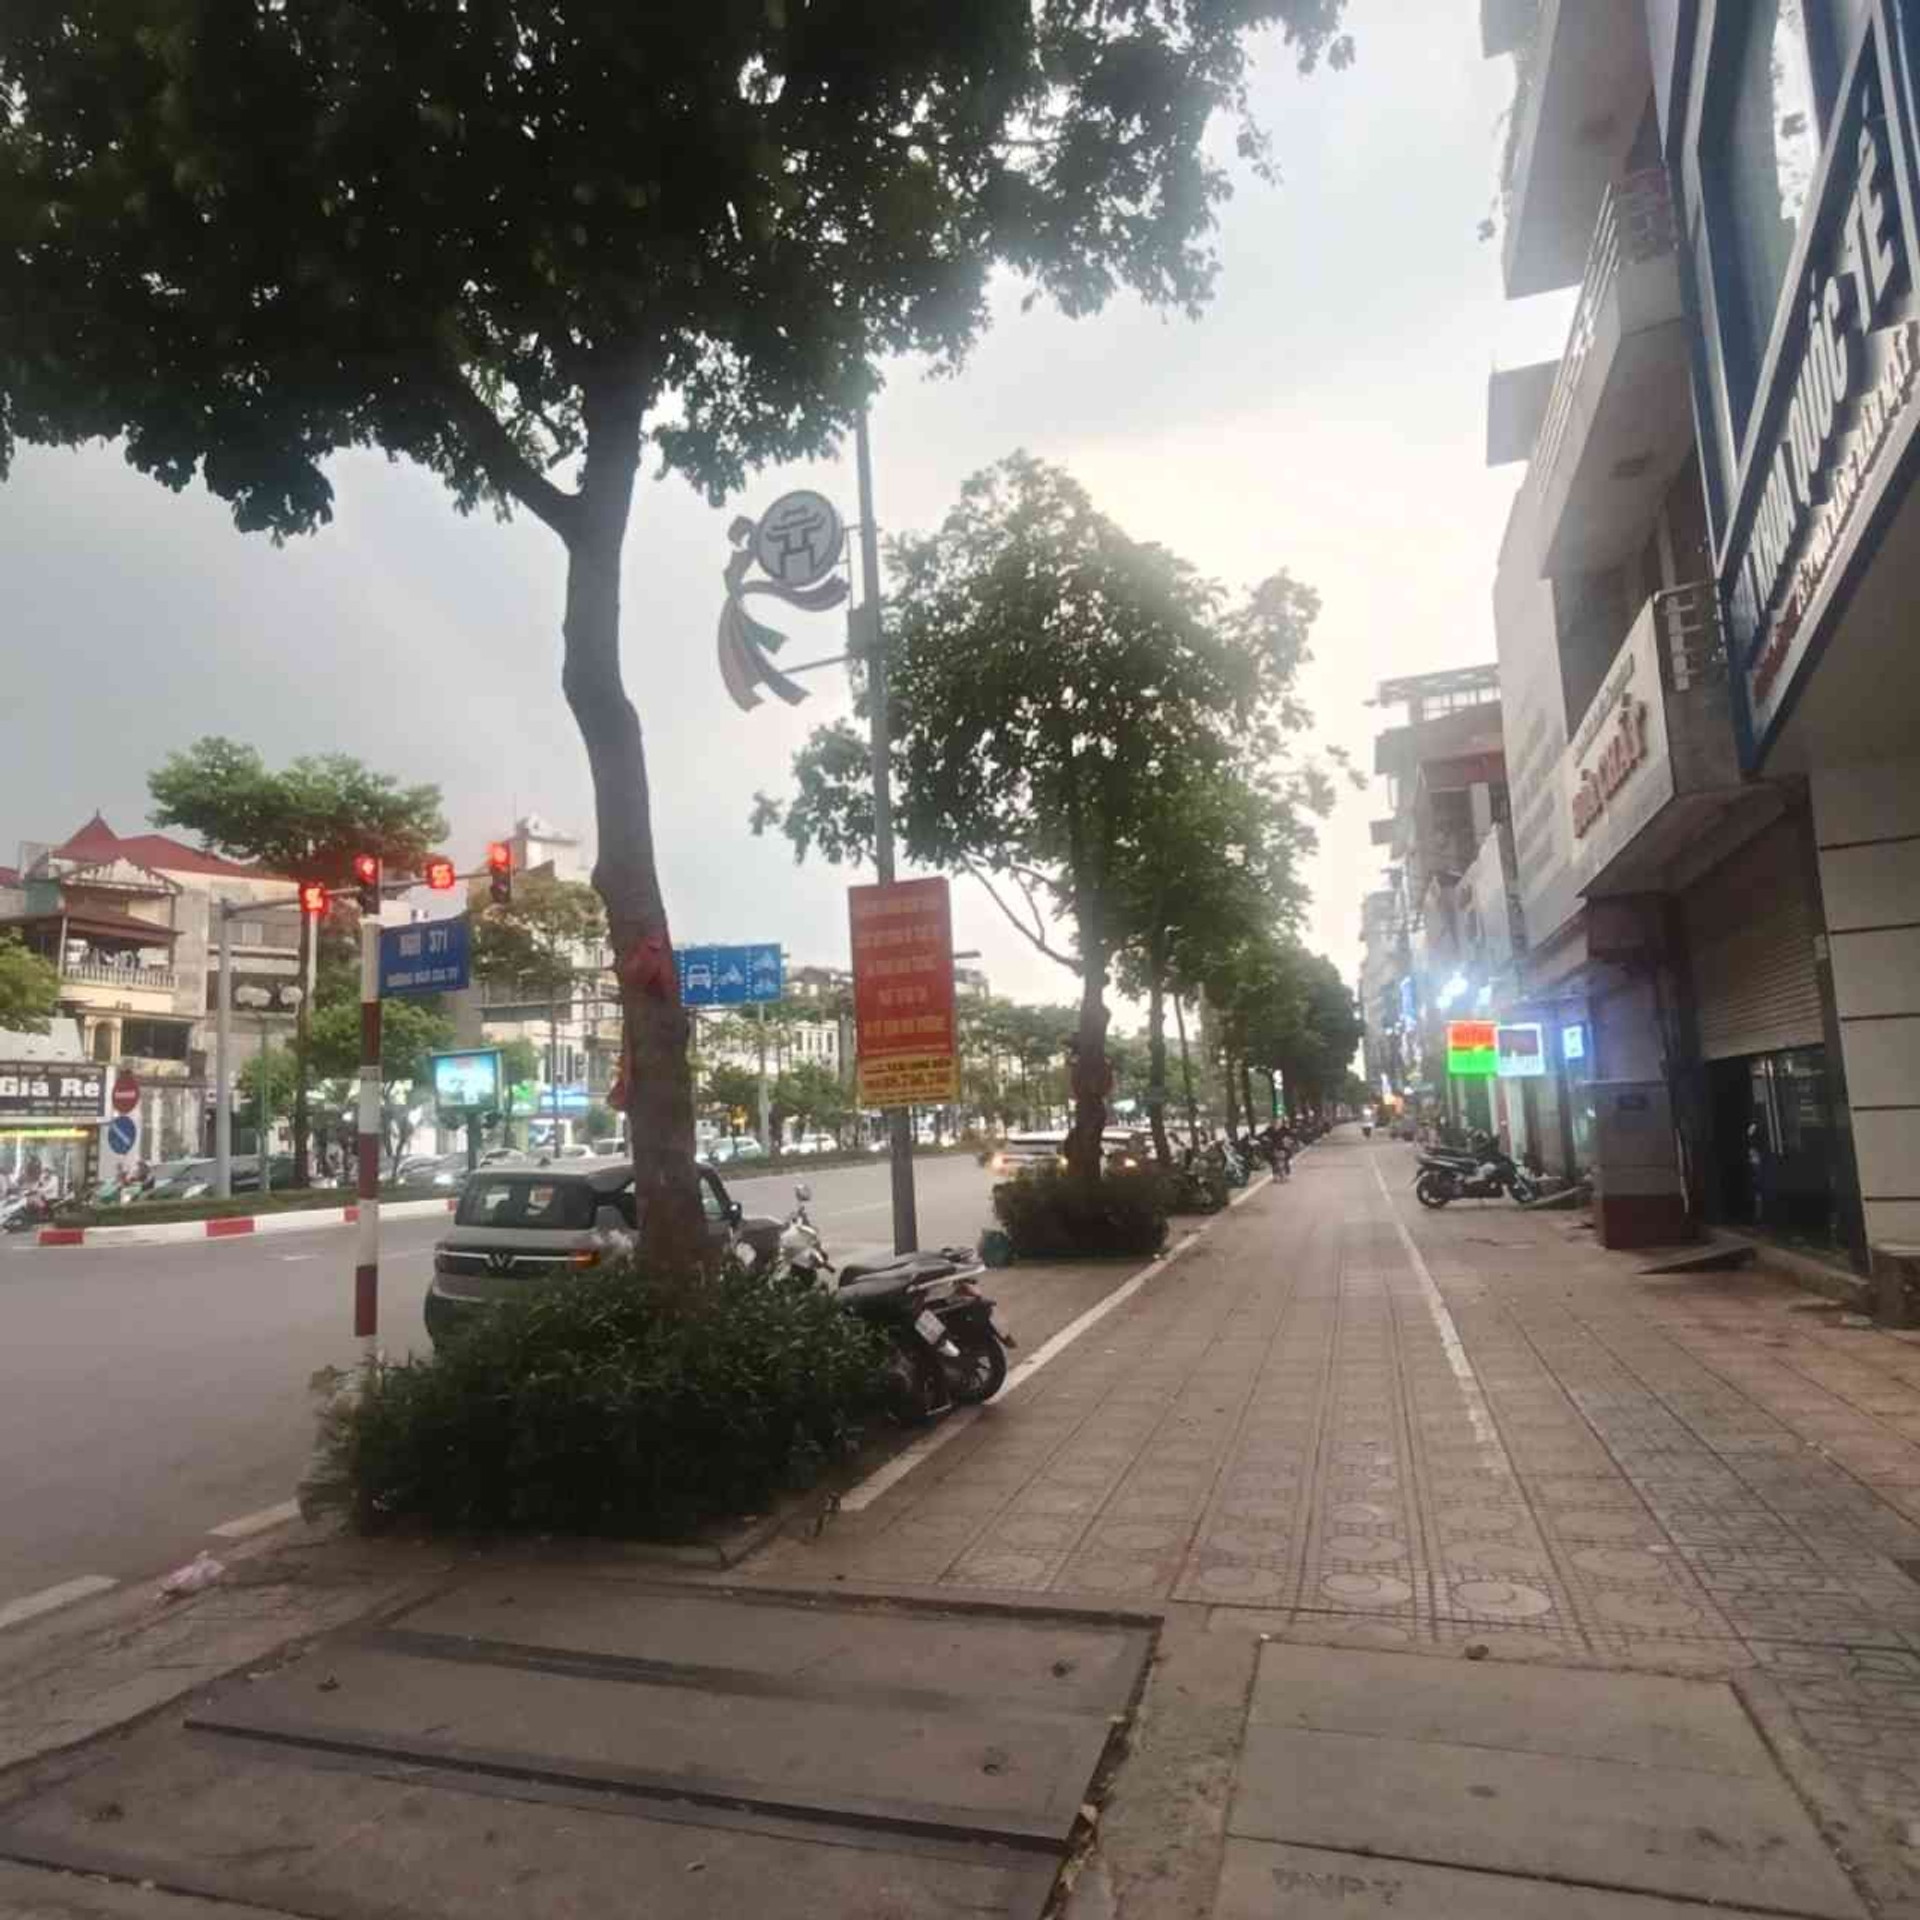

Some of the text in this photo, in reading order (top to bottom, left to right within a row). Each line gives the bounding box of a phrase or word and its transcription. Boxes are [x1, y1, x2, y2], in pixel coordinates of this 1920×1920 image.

[1751, 443, 1797, 611] KHOA
[1788, 268, 1848, 509] QUỐC
[1843, 84, 1896, 338] TẾ
[0, 1074, 50, 1097] Giá
